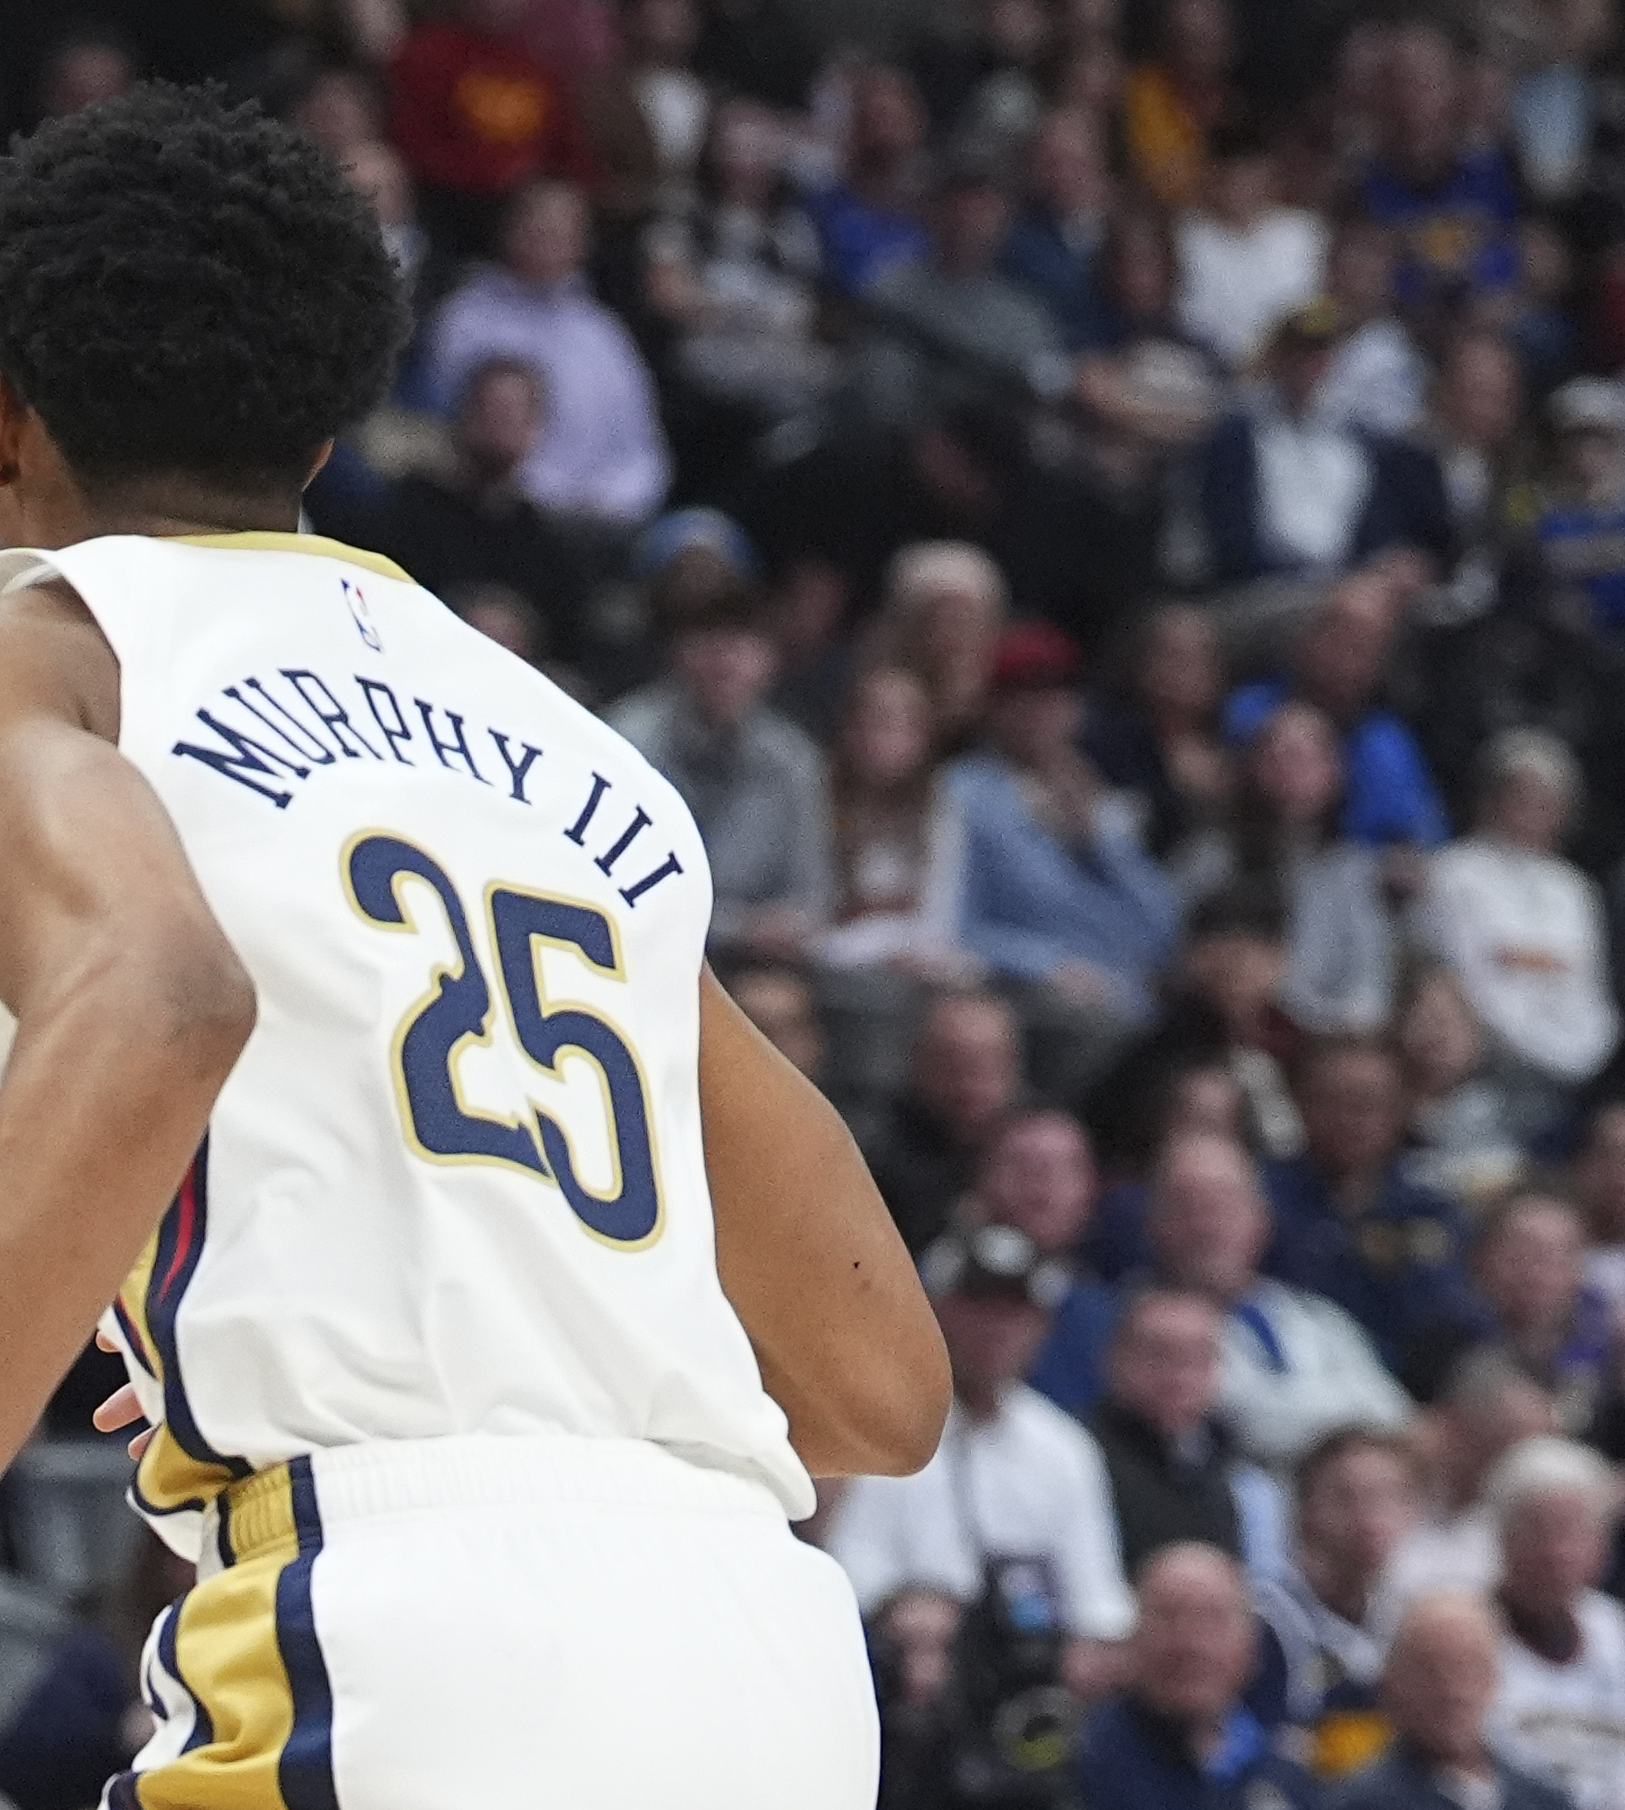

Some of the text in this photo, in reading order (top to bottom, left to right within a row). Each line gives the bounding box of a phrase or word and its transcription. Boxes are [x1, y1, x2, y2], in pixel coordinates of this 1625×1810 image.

[171, 667, 684, 909] MURPHY III
[340, 827, 667, 1253] 25
